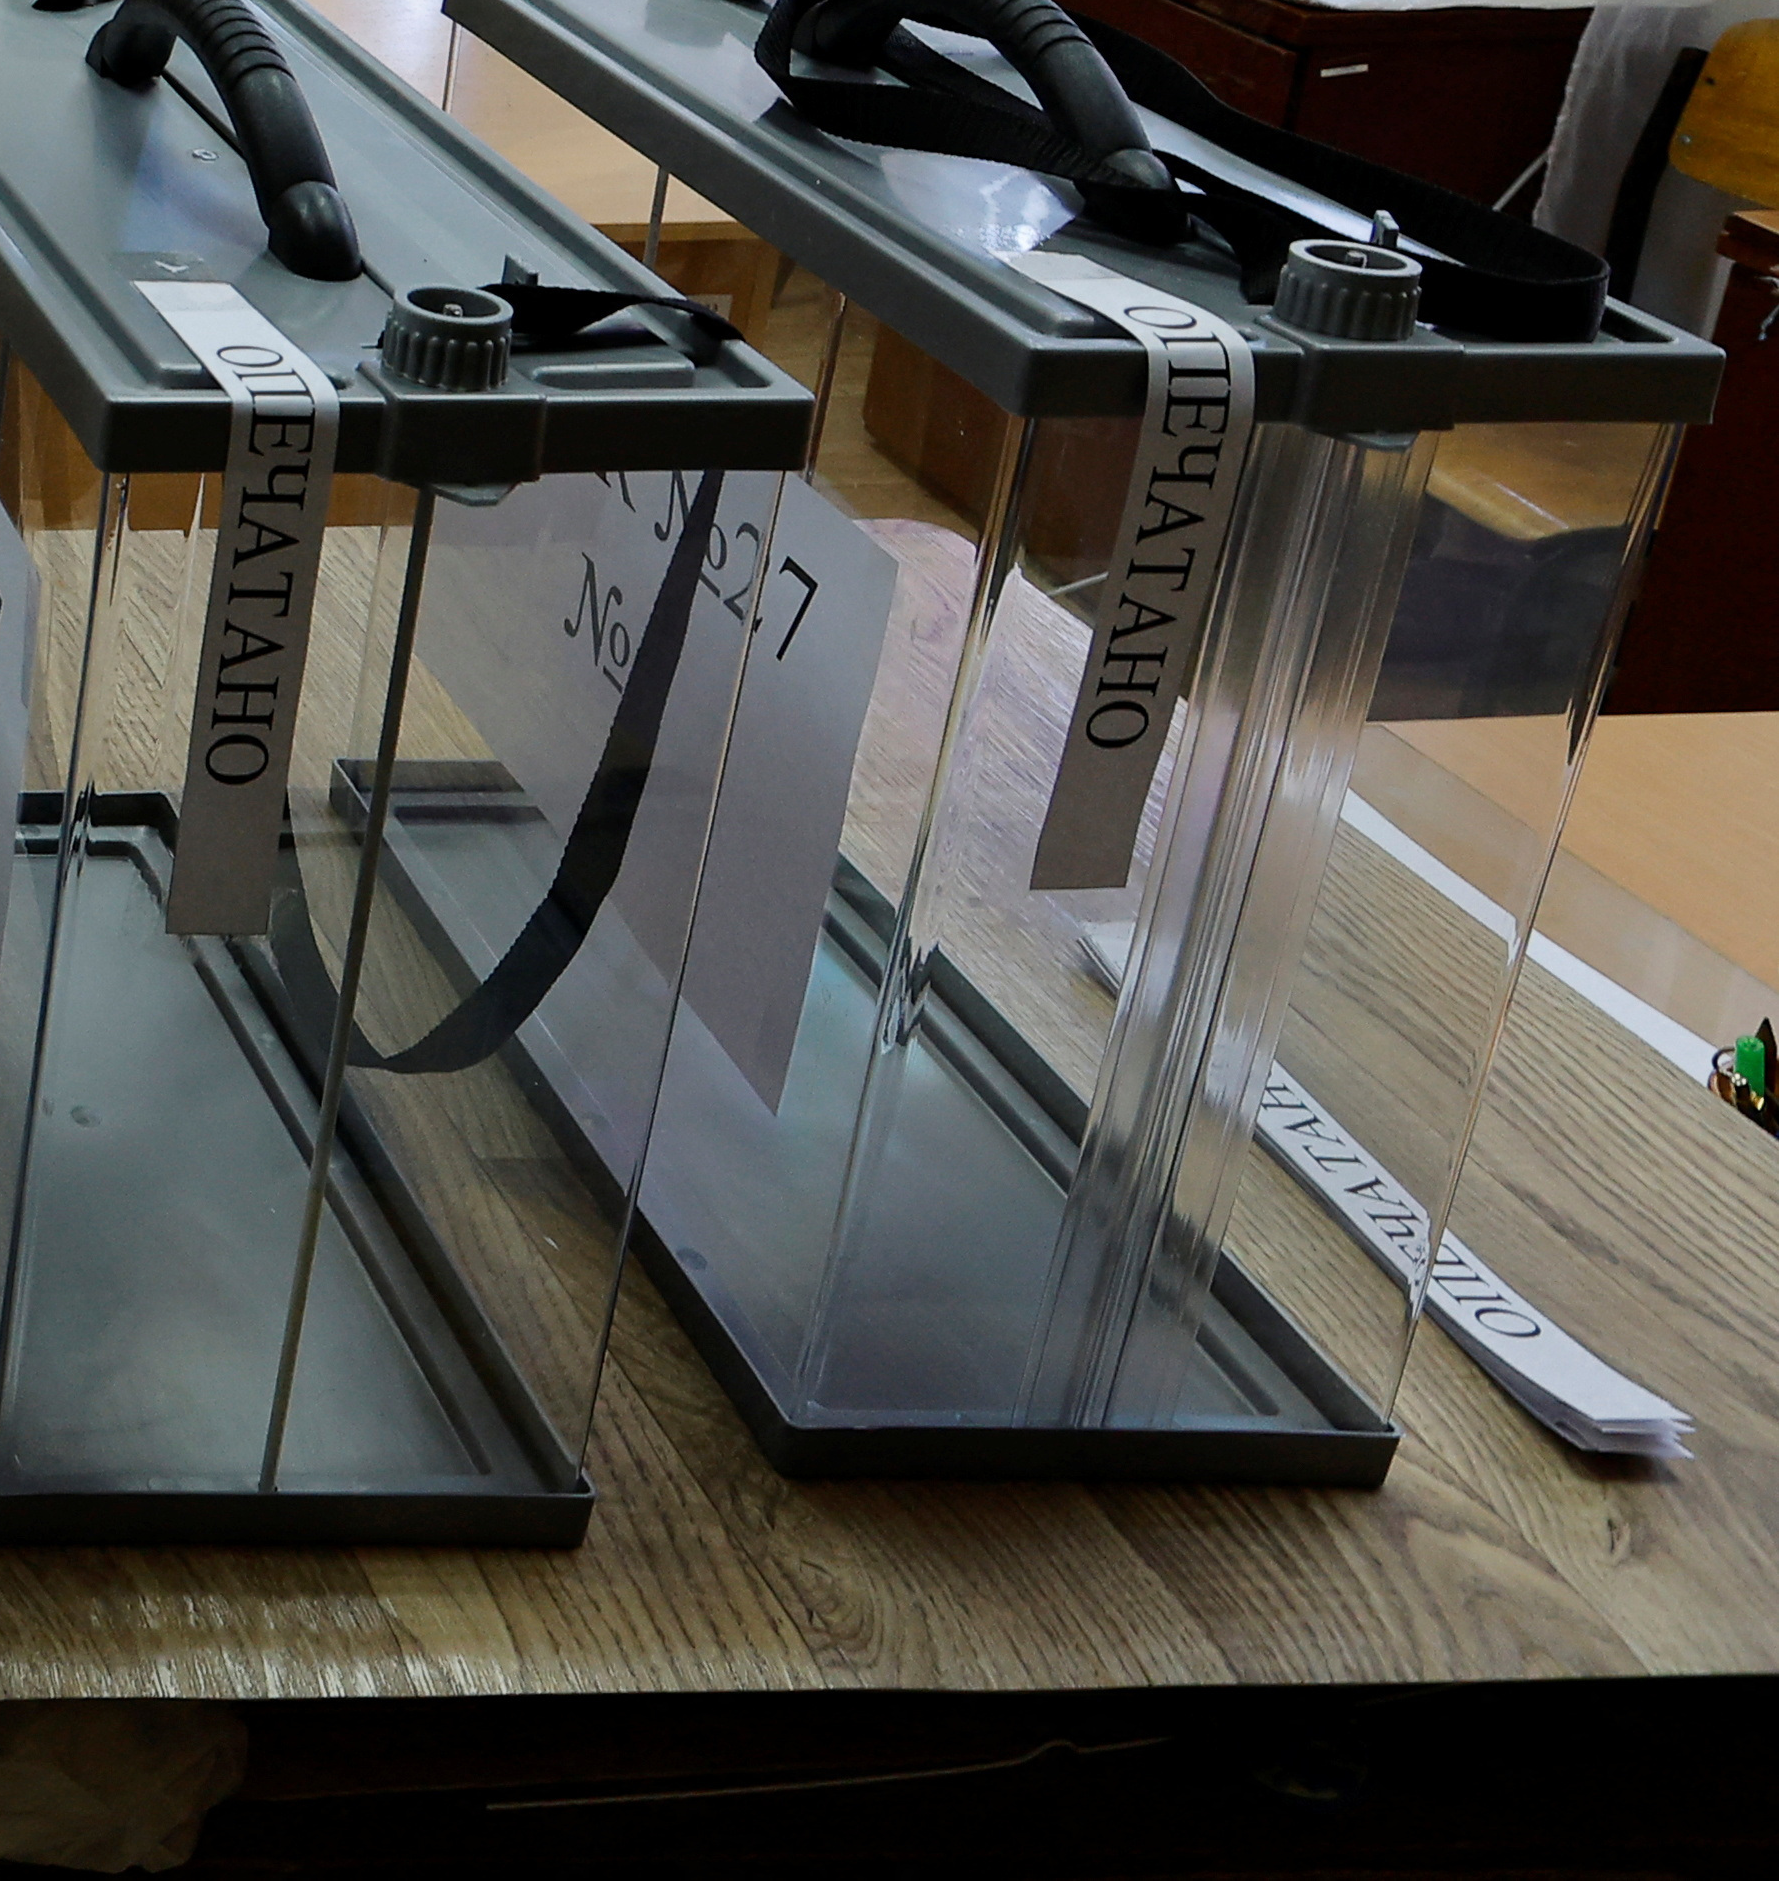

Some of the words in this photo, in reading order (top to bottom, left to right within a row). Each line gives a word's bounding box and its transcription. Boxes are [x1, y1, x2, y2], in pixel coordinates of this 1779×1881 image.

[205, 344, 316, 787] ОПЕЧАТАНО
[1085, 305, 1231, 750] ОПЕЧАТАНО
[1260, 1083, 1541, 1338] ОПЕЧАТАН
